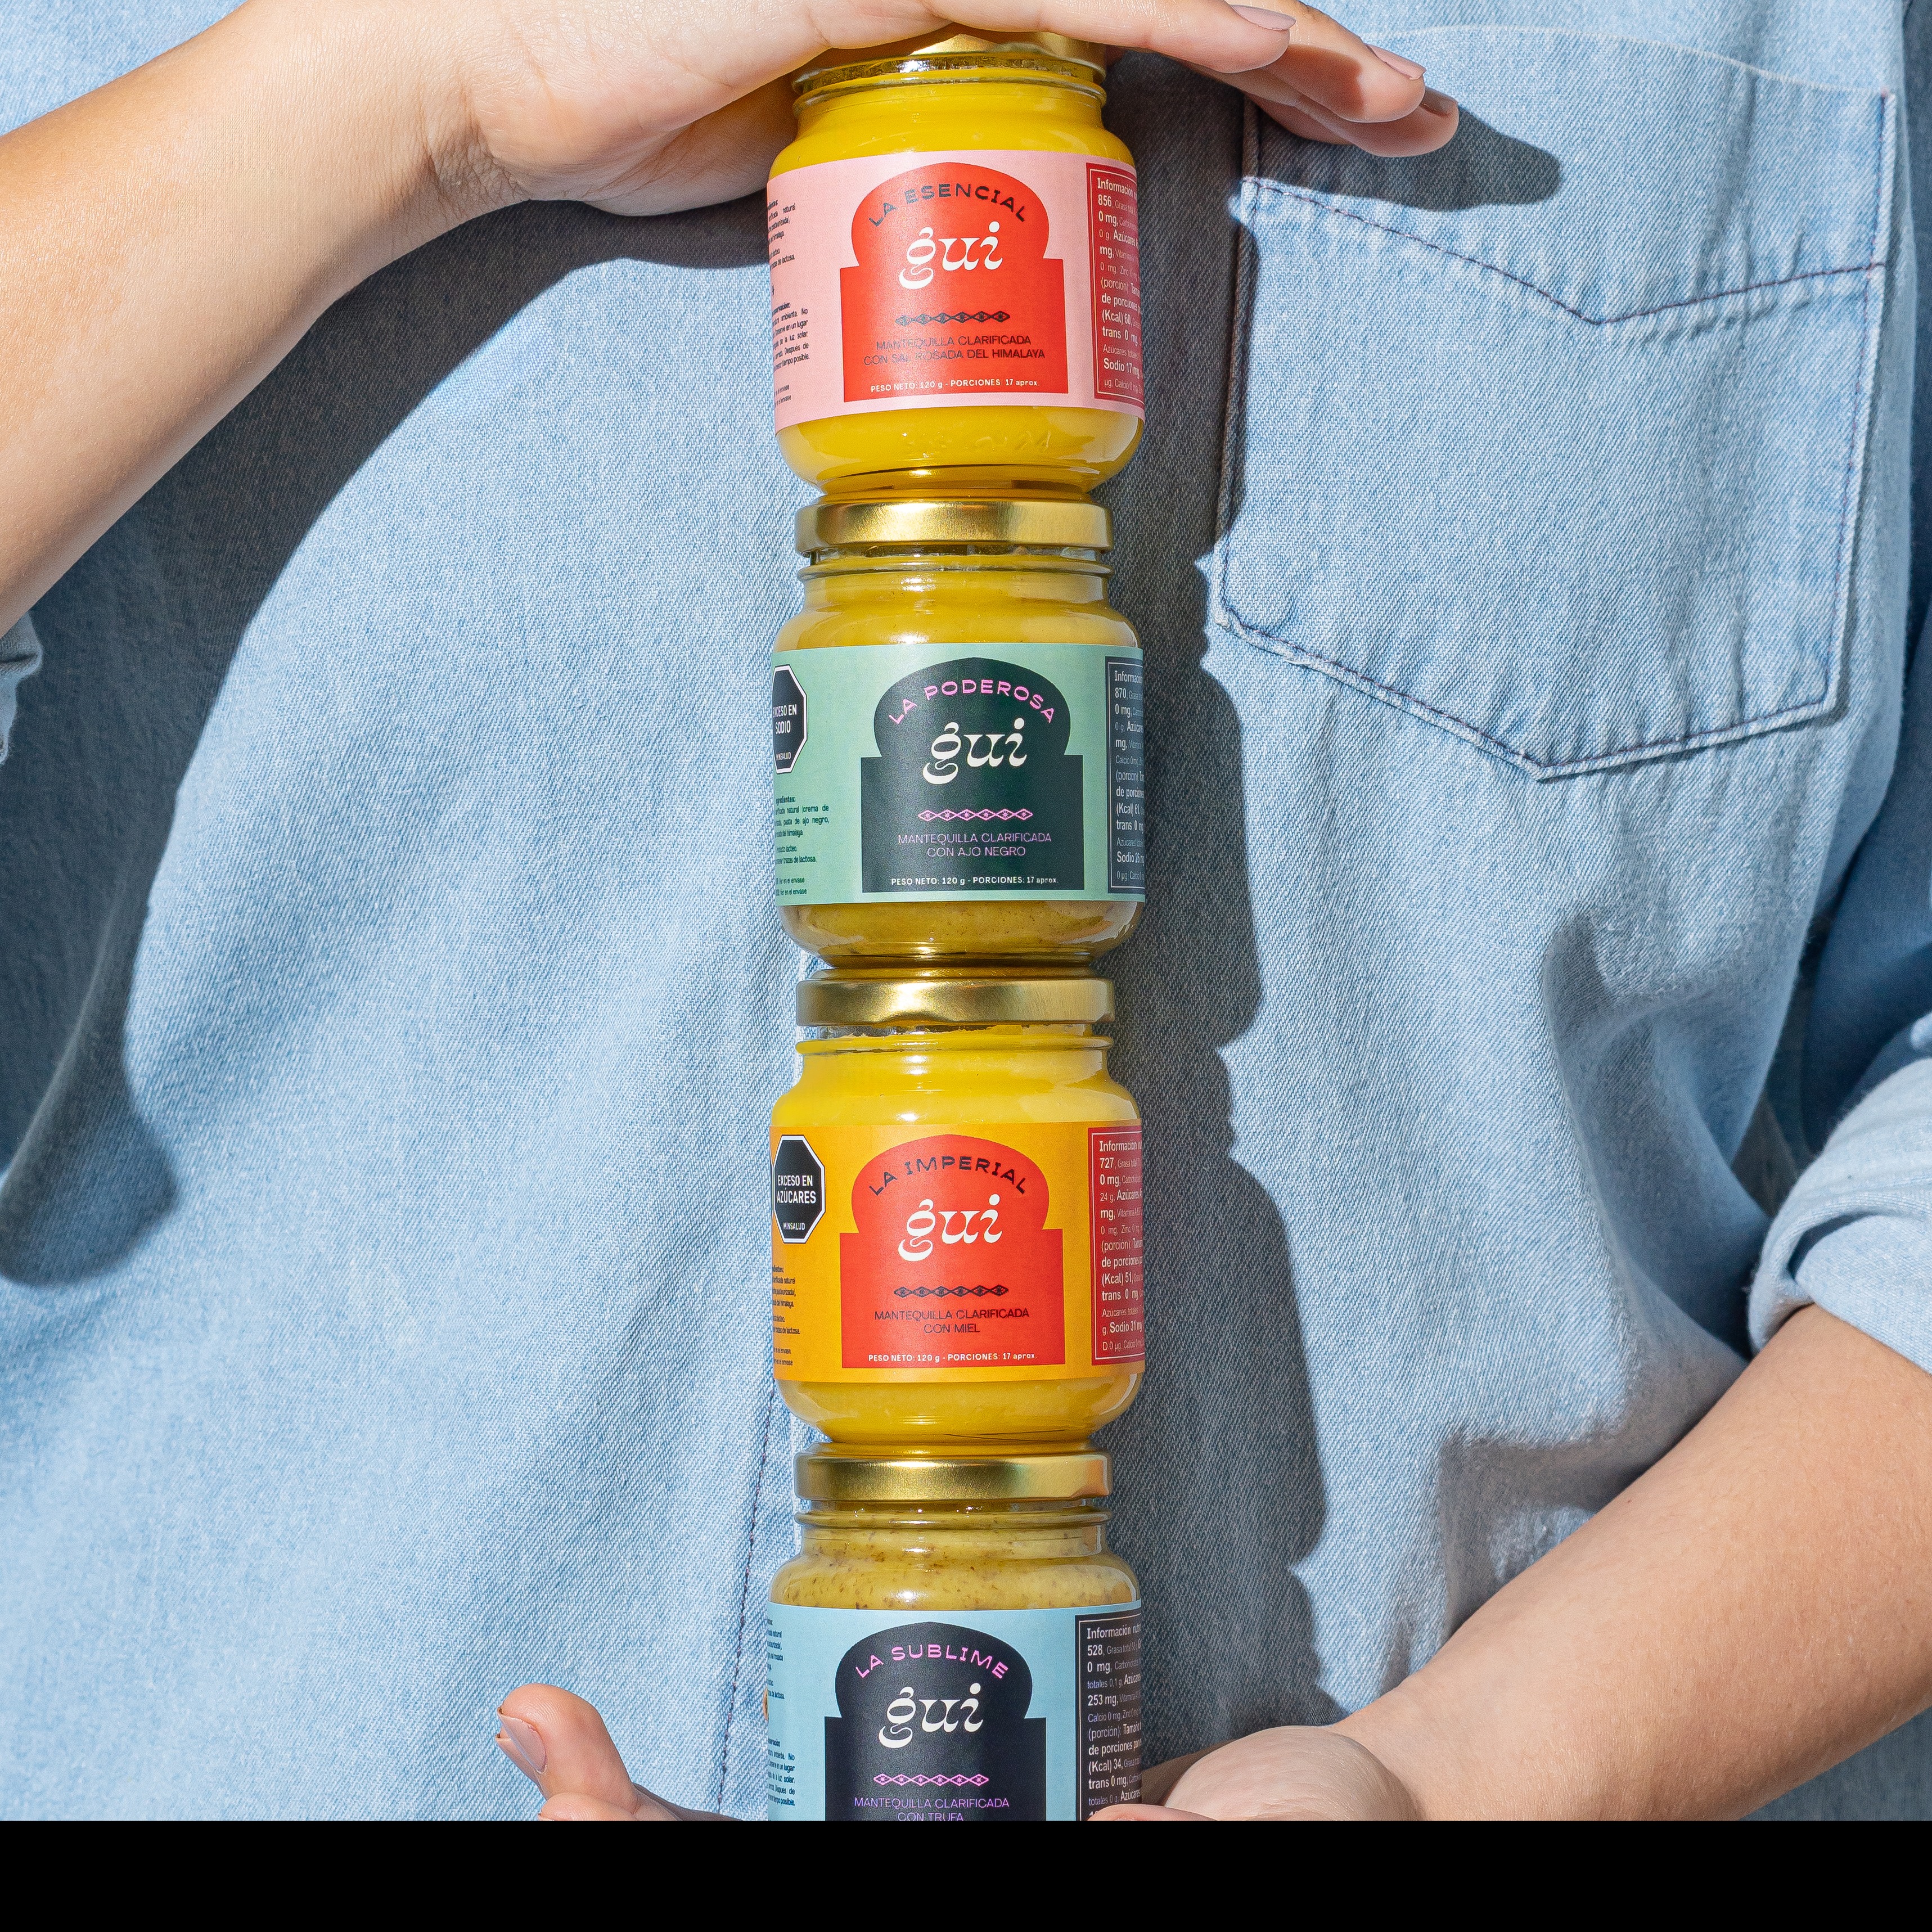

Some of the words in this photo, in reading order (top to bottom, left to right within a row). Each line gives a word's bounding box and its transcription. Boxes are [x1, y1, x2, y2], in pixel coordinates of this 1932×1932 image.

[869, 202, 897, 227] LA
[904, 183, 1025, 222] ESENCIAL
[1098, 194, 1114, 209] 856,
[1098, 210, 1104, 222] 0
[1105, 214, 1119, 227] mg,
[1099, 229, 1104, 238] 0
[899, 220, 1003, 290] gui
[1100, 246, 1115, 259] mg,
[1100, 262, 1105, 271] 0
[1101, 292, 1111, 304] de
[1102, 309, 1123, 326] (Kcal)
[1102, 326, 1122, 339] trans
[1124, 329, 1128, 341] 0
[876, 336, 954, 350] MANTEQUILLA
[958, 335, 1032, 345] CLARIFICADA
[864, 355, 888, 366] CON
[891, 353, 911, 363] SAL
[915, 349, 963, 361] ROSADA
[967, 349, 988, 359] DEL
[992, 349, 1045, 359] HIMALAYA
[1104, 357, 1125, 372] Sodio
[1126, 361, 1132, 373] 17
[871, 384, 891, 393] PESO
[894, 382, 918, 391] NETO:
[951, 379, 1003, 388] PORCIONES:
[1115, 687, 1128, 700] 870,
[889, 699, 917, 724] LA
[924, 679, 1055, 723] PODEROSA
[788, 704, 797, 716] EN
[1115, 704, 1119, 714] 0
[1121, 706, 1132, 718] mg,
[775, 720, 791, 735] SODIO
[1115, 722, 1119, 731] 0
[922, 718, 1028, 785] gui
[1115, 739, 1128, 751] mg,
[1116, 786, 1124, 797] de
[802, 805, 818, 814] (crema
[1116, 803, 1134, 817] (Kcal)
[812, 817, 830, 825] negro,
[1116, 819, 1132, 830] trans
[1134, 821, 1137, 831] 0
[898, 834, 978, 845] MANTEQUILLA
[981, 832, 1052, 843] CLARIFICADA
[927, 847, 954, 857] CON
[957, 846, 981, 857] AJO
[985, 846, 1026, 856] NEGRO
[1116, 852, 1134, 863] Sodio
[1100, 1157, 1116, 1169] 727,
[777, 1174, 800, 1186] EXCESO
[802, 1174, 813, 1187] EN
[869, 1172, 898, 1196] LA
[904, 1156, 1025, 1195] IMPERIAL
[1100, 1174, 1105, 1186] 0
[1107, 1176, 1121, 1187] mg,
[777, 1187, 816, 1204] AZÚCARES
[1100, 1193, 1108, 1202] 24
[1101, 1209, 1115, 1221] mg,
[898, 1194, 1003, 1262] gui
[1101, 1226, 1105, 1235] 0
[1101, 1256, 1111, 1268] de
[1113, 1255, 1139, 1269] porciones
[1102, 1273, 1124, 1288] (Kcal)
[1102, 1290, 1121, 1301] trans
[1125, 1288, 1129, 1299] 0
[875, 1310, 953, 1322] MANTEQUILLA
[956, 1308, 1029, 1319] CLARIFICADA
[924, 1323, 950, 1333] CON
[954, 1323, 980, 1333] MIEL
[1110, 1321, 1129, 1334] Sodio
[1131, 1321, 1136, 1331] 31
[1087, 1624, 1131, 1639] Información
[1087, 1645, 1105, 1657] 528,
[1107, 1645, 1122, 1655] Grasa
[855, 1655, 884, 1678] LA
[891, 1644, 1008, 1679] SUBLIME
[1087, 1661, 1093, 1673] 0
[1097, 1662, 1112, 1674] mg,
[1087, 1679, 1107, 1689] totales
[1088, 1694, 1103, 1706] 253
[1105, 1695, 1119, 1706] mg,
[879, 1683, 983, 1749] gui
[1088, 1713, 1107, 1722] Calcio
[1108, 1712, 1112, 1721] 0
[1089, 1744, 1099, 1755] de
[1101, 1741, 1133, 1757] porciones
[784, 1763, 795, 1773] lugar
[1089, 1759, 1111, 1775] (Kcal)
[1114, 1758, 1123, 1771] 34,
[1089, 1778, 1109, 1790] trans
[1111, 1776, 1115, 1787] 0
[1116, 1776, 1128, 1787] mg,
[854, 1797, 931, 1809] MANTEQUILLA
[935, 1798, 1010, 1808] CLARIFICADA
[1089, 1796, 1109, 1806] totales
[898, 1812, 924, 1821] CON
[928, 1812, 964, 1821] TRUFA
